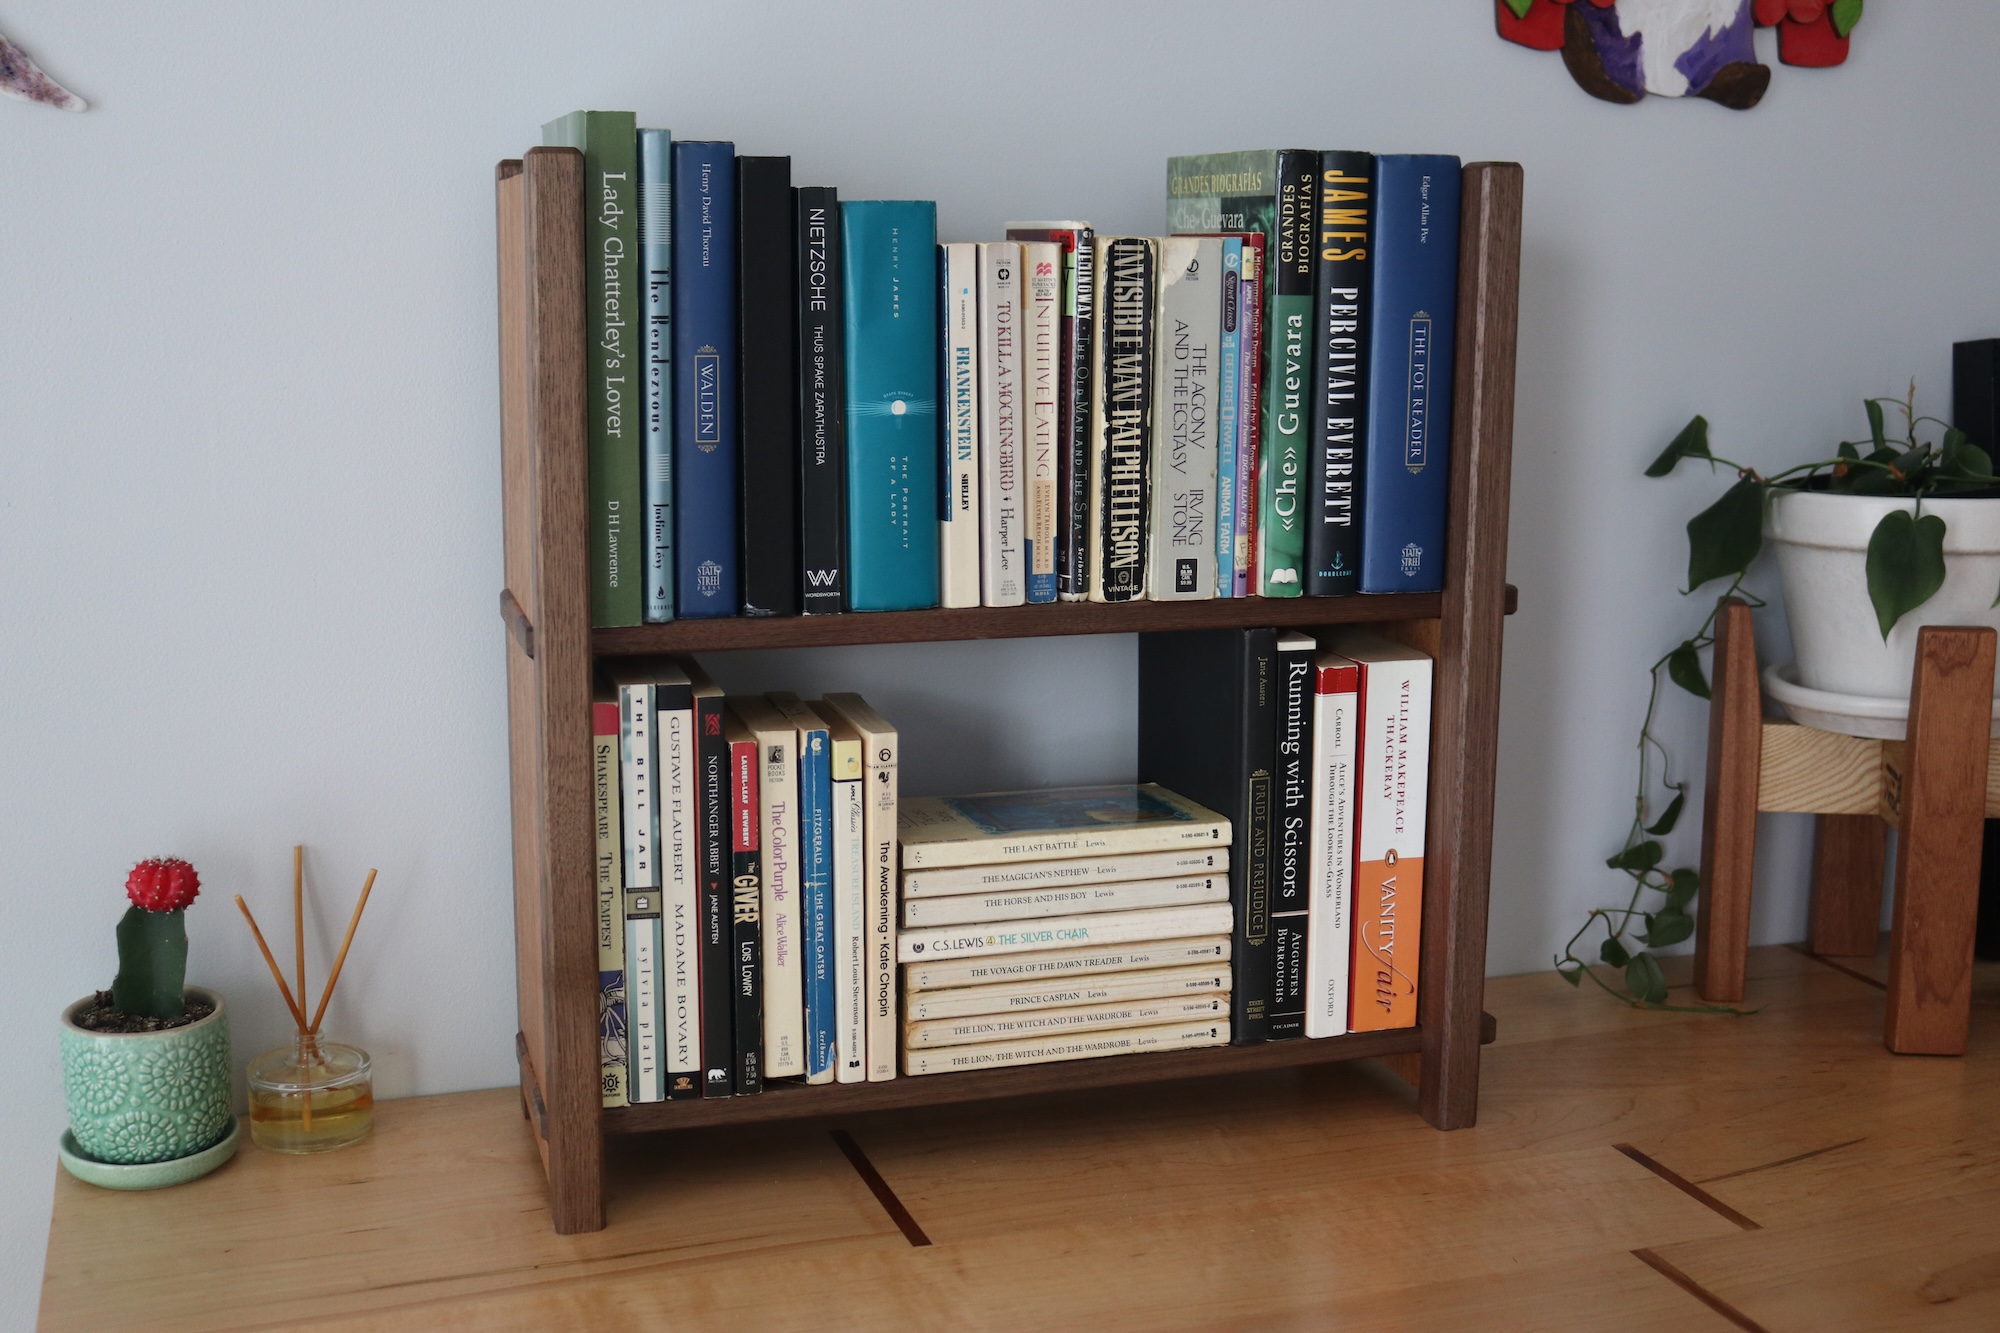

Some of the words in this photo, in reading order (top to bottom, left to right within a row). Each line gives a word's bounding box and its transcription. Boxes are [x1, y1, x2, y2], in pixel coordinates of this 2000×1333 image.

[700, 163, 712, 193] Henry
[1171, 174, 1209, 195] GRANDES
[1211, 168, 1262, 193] BIOGRAFÍAS
[1419, 175, 1431, 201] Edgar
[599, 172, 626, 230] Lady
[701, 196, 712, 225] David
[1321, 169, 1369, 261] JAMES
[1421, 203, 1430, 225] Allan
[1280, 184, 1295, 263] GRANDES
[1297, 173, 1313, 274] BIOGRAFÍAS
[1420, 228, 1429, 244] Poe
[702, 227, 712, 267] Thoreau
[809, 208, 826, 312] NIETZSCHE
[601, 237, 625, 368] Chatterley's
[650, 267, 669, 303] The
[892, 277, 900, 319] JAMES
[1076, 245, 1092, 321] HEMINGWAY
[1112, 243, 1145, 349] INVISIBLE
[1225, 275, 1237, 300] Signet
[997, 301, 1011, 323] TO
[1226, 300, 1237, 330] Classic
[814, 325, 824, 353] THUS
[997, 327, 1012, 363] KILL
[1034, 297, 1054, 396] INTUITIVE
[1076, 335, 1090, 360] THE
[1174, 319, 1190, 360] AND
[1327, 286, 1359, 405] PERCIVAL
[1413, 326, 1427, 356] THE
[650, 316, 669, 432] Rendezvous
[814, 356, 825, 389] SPAKE
[998, 366, 1012, 377] A
[1111, 354, 1143, 403] MAN
[1192, 344, 1207, 376] THE
[1224, 352, 1234, 405] GEORGE
[1243, 365, 1251, 388] Raven
[1277, 313, 1303, 435] Guevara
[1412, 363, 1426, 391] POE
[700, 364, 714, 434] WALDEN
[1076, 366, 1090, 396] OLD
[1173, 368, 1189, 398] THE
[606, 376, 625, 438] Lover
[955, 347, 972, 461] FRANKENSTEIN
[1075, 401, 1089, 433] MAN
[1188, 381, 1207, 450] AGONY
[815, 391, 825, 466] ZARATHUSTRA
[998, 382, 1014, 491] MOCKINGBIRD
[1034, 401, 1054, 477] EATING
[1110, 408, 1142, 480] RALPH
[1170, 402, 1188, 475] ECSTASY
[1222, 405, 1235, 467] ORWELL
[1410, 398, 1424, 458] READER
[890, 456, 896, 471] OF
[1074, 440, 1084, 466] AND
[1323, 417, 1355, 527] EVERETT
[961, 474, 969, 512] SHELLEY
[1074, 470, 1088, 496] THE
[1220, 476, 1232, 521] ANIMAL
[1240, 484, 1248, 509] ALLAN
[608, 501, 620, 511] D
[609, 515, 620, 525] H
[653, 504, 670, 542] Justine
[1074, 502, 1087, 531] SEA
[1110, 483, 1141, 569] ELLISON
[1172, 493, 1188, 547] STONE
[1188, 489, 1204, 546] IRVING
[999, 508, 1014, 547] Harper
[1220, 523, 1231, 554] FARM
[608, 529, 620, 588] Lawrence
[653, 546, 670, 570] Lévy
[1001, 549, 1015, 571] Lee
[1077, 547, 1085, 587] Scribners
[1258, 656, 1269, 676] Jane
[1259, 677, 1268, 707] Austen
[1280, 661, 1308, 755] Running
[1398, 679, 1410, 745] WILLIAM
[635, 697, 644, 738] THE
[1334, 708, 1344, 749] CARROLL
[670, 716, 681, 795] GUSTAVE
[1383, 714, 1396, 801] THACKERAY
[596, 744, 611, 839] SHAKESPEARE
[636, 758, 645, 810] BELL
[707, 755, 720, 838] NORTHANGER
[1254, 784, 1266, 822] PRIDE
[1284, 759, 1305, 808] with
[1394, 749, 1407, 835] MAKEPEACE
[771, 801, 787, 825] The
[638, 829, 646, 870] JAR
[671, 799, 683, 885] FLAUBERT
[772, 827, 787, 861] Color
[814, 808, 822, 865] FITZGERALD
[880, 840, 890, 863] The
[1003, 845, 1021, 854] THE
[1022, 844, 1045, 853] LAST
[1045, 841, 1078, 851] BATTLE
[1253, 827, 1265, 858] AND
[1282, 816, 1303, 898] Scissors
[599, 851, 613, 883] THE
[708, 839, 720, 876] ABBEY
[747, 862, 757, 874] The
[851, 836, 859, 890] TREASURE
[733, 874, 760, 925] GIVER
[771, 861, 788, 902] Purple
[816, 893, 824, 910] THE
[877, 866, 890, 934] Awakening
[1252, 863, 1264, 932] PREJUDICE
[600, 887, 614, 950] TEMPEST
[709, 894, 718, 913] JANE
[851, 891, 860, 931] ISLAND
[1378, 875, 1397, 956] VANITY
[674, 903, 686, 987] MADAME
[710, 914, 719, 945] AUSTEN
[776, 913, 787, 936] Alice
[816, 912, 824, 944] GREAT
[932, 940, 952, 951] C.S.
[952, 937, 984, 950] LEWIS
[998, 934, 1017, 945] THE
[1020, 931, 1053, 944] SILVER
[1056, 928, 1089, 941] CHAIR
[741, 941, 755, 962] LOIS
[776, 935, 788, 968] Walker
[817, 946, 825, 980] GATSBY
[879, 943, 890, 971] Kate
[1275, 928, 1288, 1004] BURROUGHS
[1289, 932, 1302, 997] AUGUSTEN
[637, 947, 654, 1008] sylvia
[741, 964, 755, 997] LOWRY
[877, 972, 890, 1017] Chopin
[1327, 979, 1335, 1017] OXFORD
[634, 1023, 654, 1074] plath
[677, 995, 688, 1066] BOVARY
